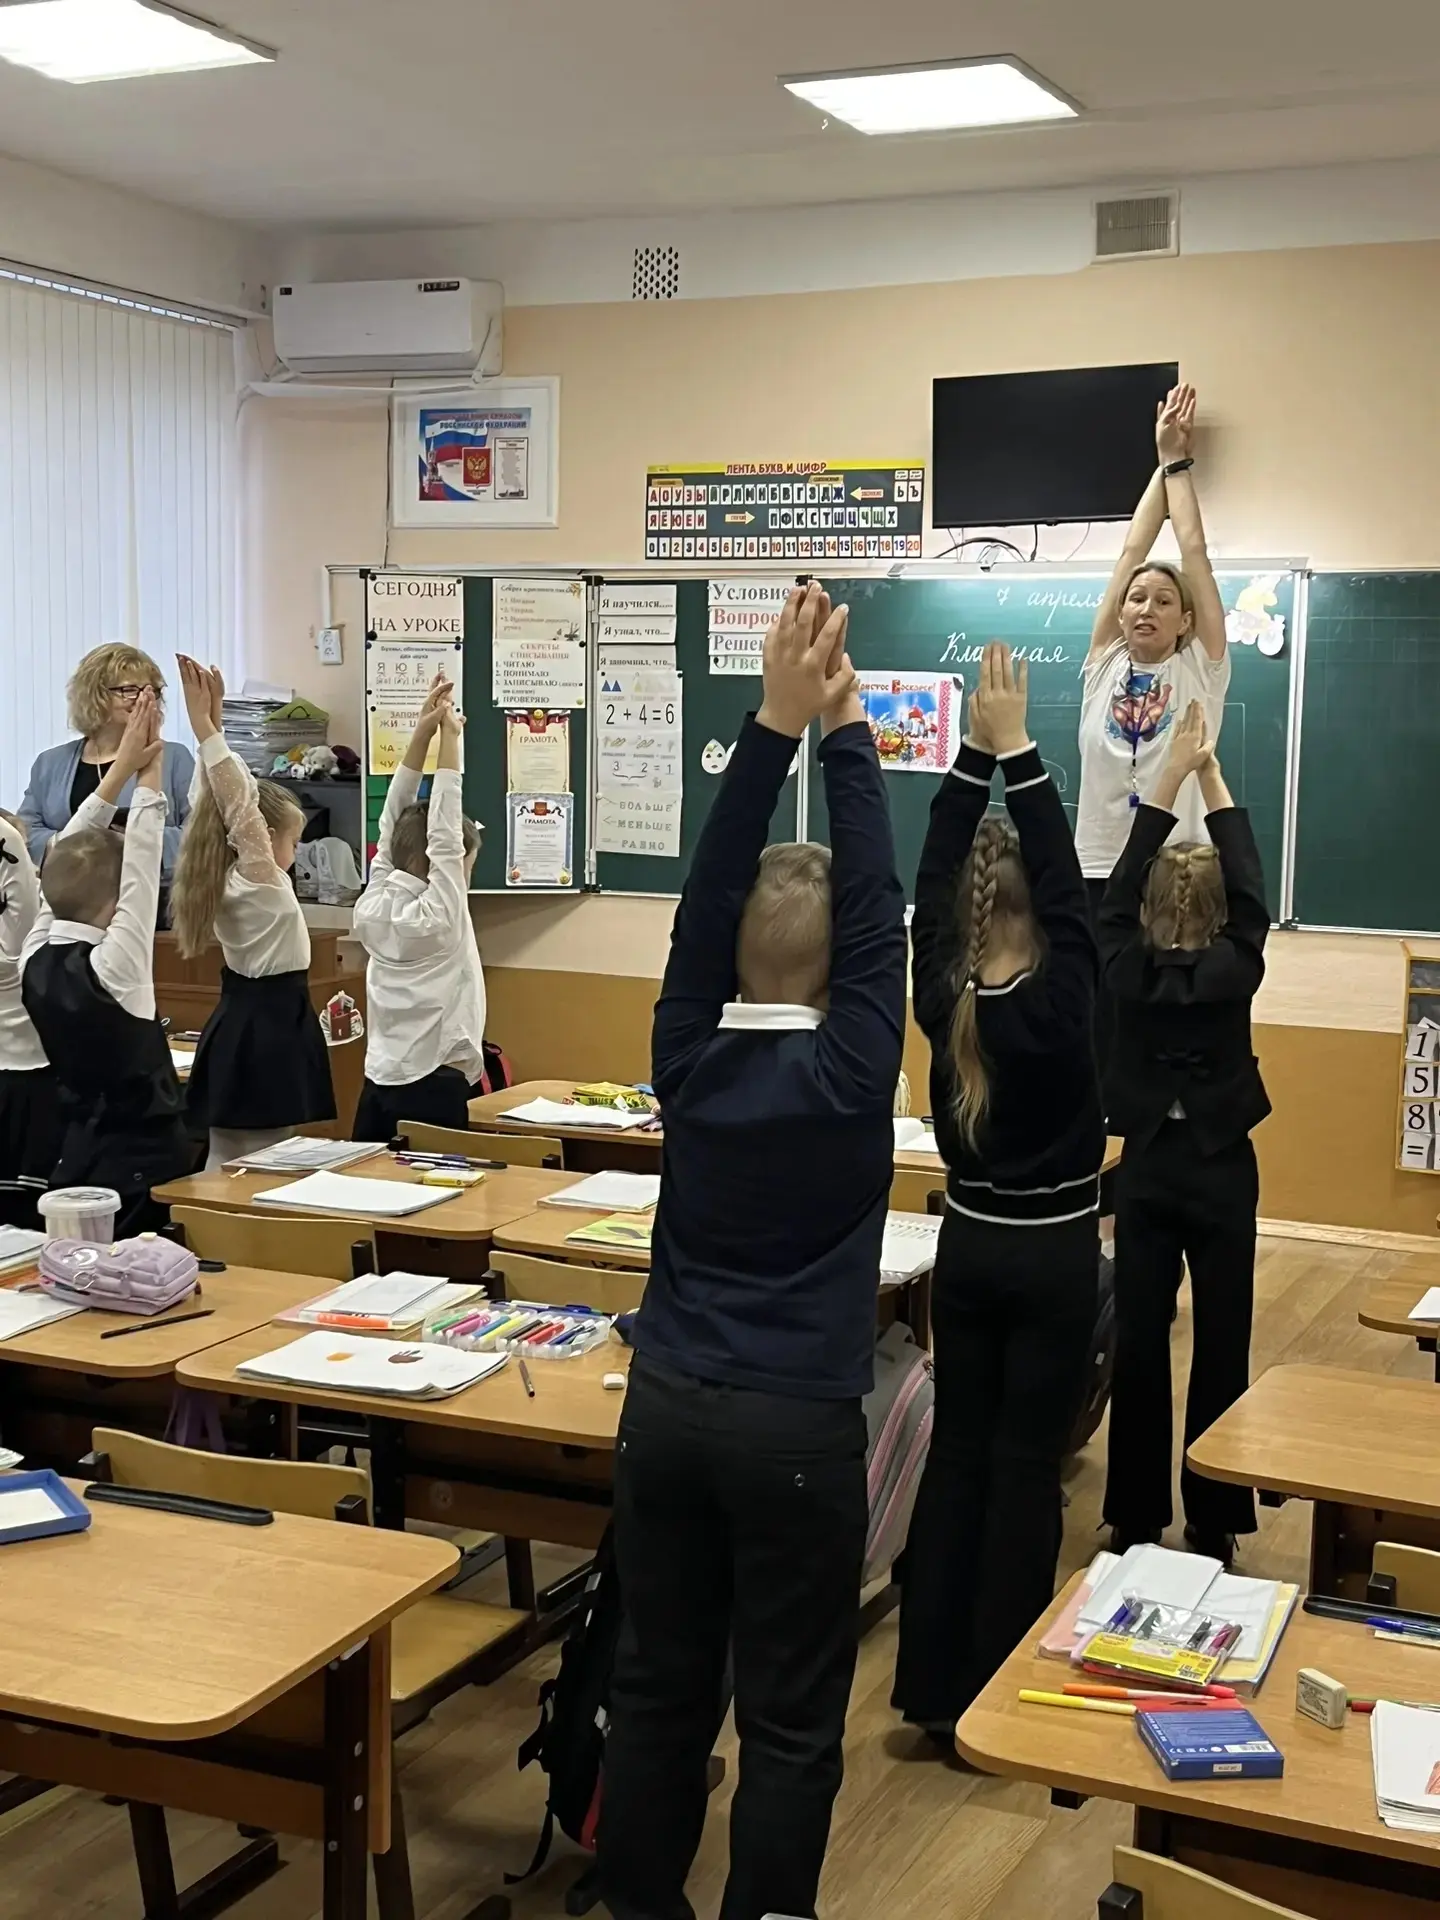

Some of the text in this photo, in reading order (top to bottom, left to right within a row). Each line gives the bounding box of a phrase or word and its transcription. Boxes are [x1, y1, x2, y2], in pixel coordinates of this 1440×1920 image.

[726, 462, 827, 474] ЛЕНТА БУКВ И ЦИФР
[650, 490, 658, 503] А
[662, 490, 669, 503] О
[675, 490, 682, 502] У
[695, 490, 706, 502] Ы
[722, 488, 730, 502] Р
[770, 487, 778, 501] Б
[797, 487, 803, 500] Г
[821, 487, 830, 501] Д
[833, 486, 843, 500] Ж
[650, 514, 657, 527] Я
[672, 514, 681, 527] Ю
[686, 514, 692, 527] Е
[698, 514, 704, 526] И
[770, 513, 777, 527] П
[797, 512, 804, 526] К
[810, 512, 817, 526] С
[823, 511, 830, 525] Т
[834, 511, 843, 525] Ш
[848, 511, 856, 527] Ц
[888, 510, 895, 524] Х
[649, 540, 919, 553] 0 1 2 3 4 5 6 7 8 9 10 11 12 13 14 15 16 17 18 19 20
[373, 581, 457, 598] СЕГОДНЯ
[712, 583, 790, 600] Условие
[996, 586, 1011, 606] 7
[602, 598, 610, 608] Я
[372, 617, 461, 632] НА УРОКЕ
[713, 607, 780, 629] Вопрос
[604, 626, 612, 636] Я
[939, 631, 1071, 664] Кланая
[377, 662, 385, 672] Я
[395, 662, 408, 672] Ю
[600, 657, 607, 666] Я
[713, 655, 761, 670] Отве
[857, 682, 889, 691] ристос
[503, 696, 550, 704] ПРОВЕРЯЮ
[390, 711, 419, 719] ЗАПОМ
[606, 703, 675, 725] 2 + 4 = 6
[379, 720, 398, 728] ЖИ
[519, 736, 558, 744] ГРАМОТА
[380, 744, 394, 752] ЧА
[380, 760, 394, 768] ЧУ
[613, 761, 620, 771] 3
[641, 762, 648, 773] 2
[617, 819, 672, 832] МЕНЬШЕ
[621, 839, 665, 851] РАВНО
[1412, 1031, 1428, 1058] 1
[1412, 1066, 1429, 1094] 5
[1408, 1104, 1426, 1130] 8
